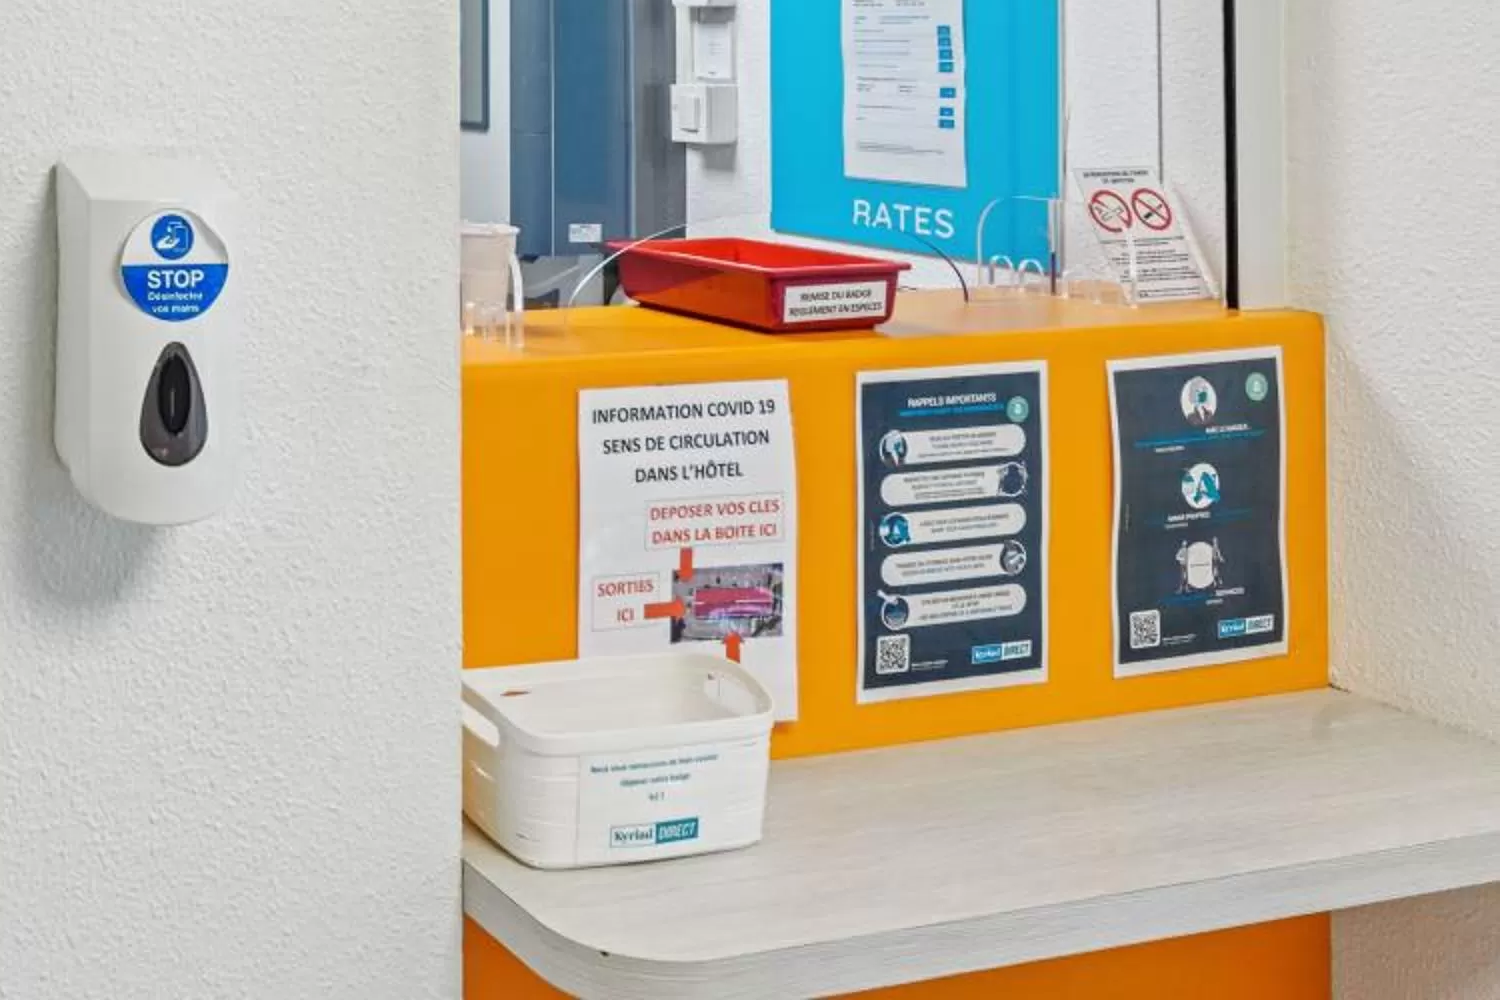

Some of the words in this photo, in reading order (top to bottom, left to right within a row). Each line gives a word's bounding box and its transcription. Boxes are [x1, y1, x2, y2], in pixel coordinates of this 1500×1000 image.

[852, 198, 956, 240] RATES
[147, 269, 205, 290] STOP
[592, 403, 704, 425] INFORMATION
[707, 400, 755, 418] COVID
[758, 398, 776, 415] 19
[602, 436, 642, 455] SENS
[645, 435, 665, 452] DE
[669, 429, 771, 451] CIRCULATION
[635, 465, 678, 484] DANS
[682, 459, 745, 481] L'HÔTEL
[650, 501, 713, 521] DEPOSER
[716, 501, 746, 517] VOS
[652, 528, 691, 544] DANS
[694, 526, 712, 541] LA
[759, 522, 778, 537] ICI
[597, 579, 655, 598] SORTIES
[616, 607, 635, 622] ICI
[614, 827, 653, 845] Kyriad
[658, 822, 697, 841] DIRECT
